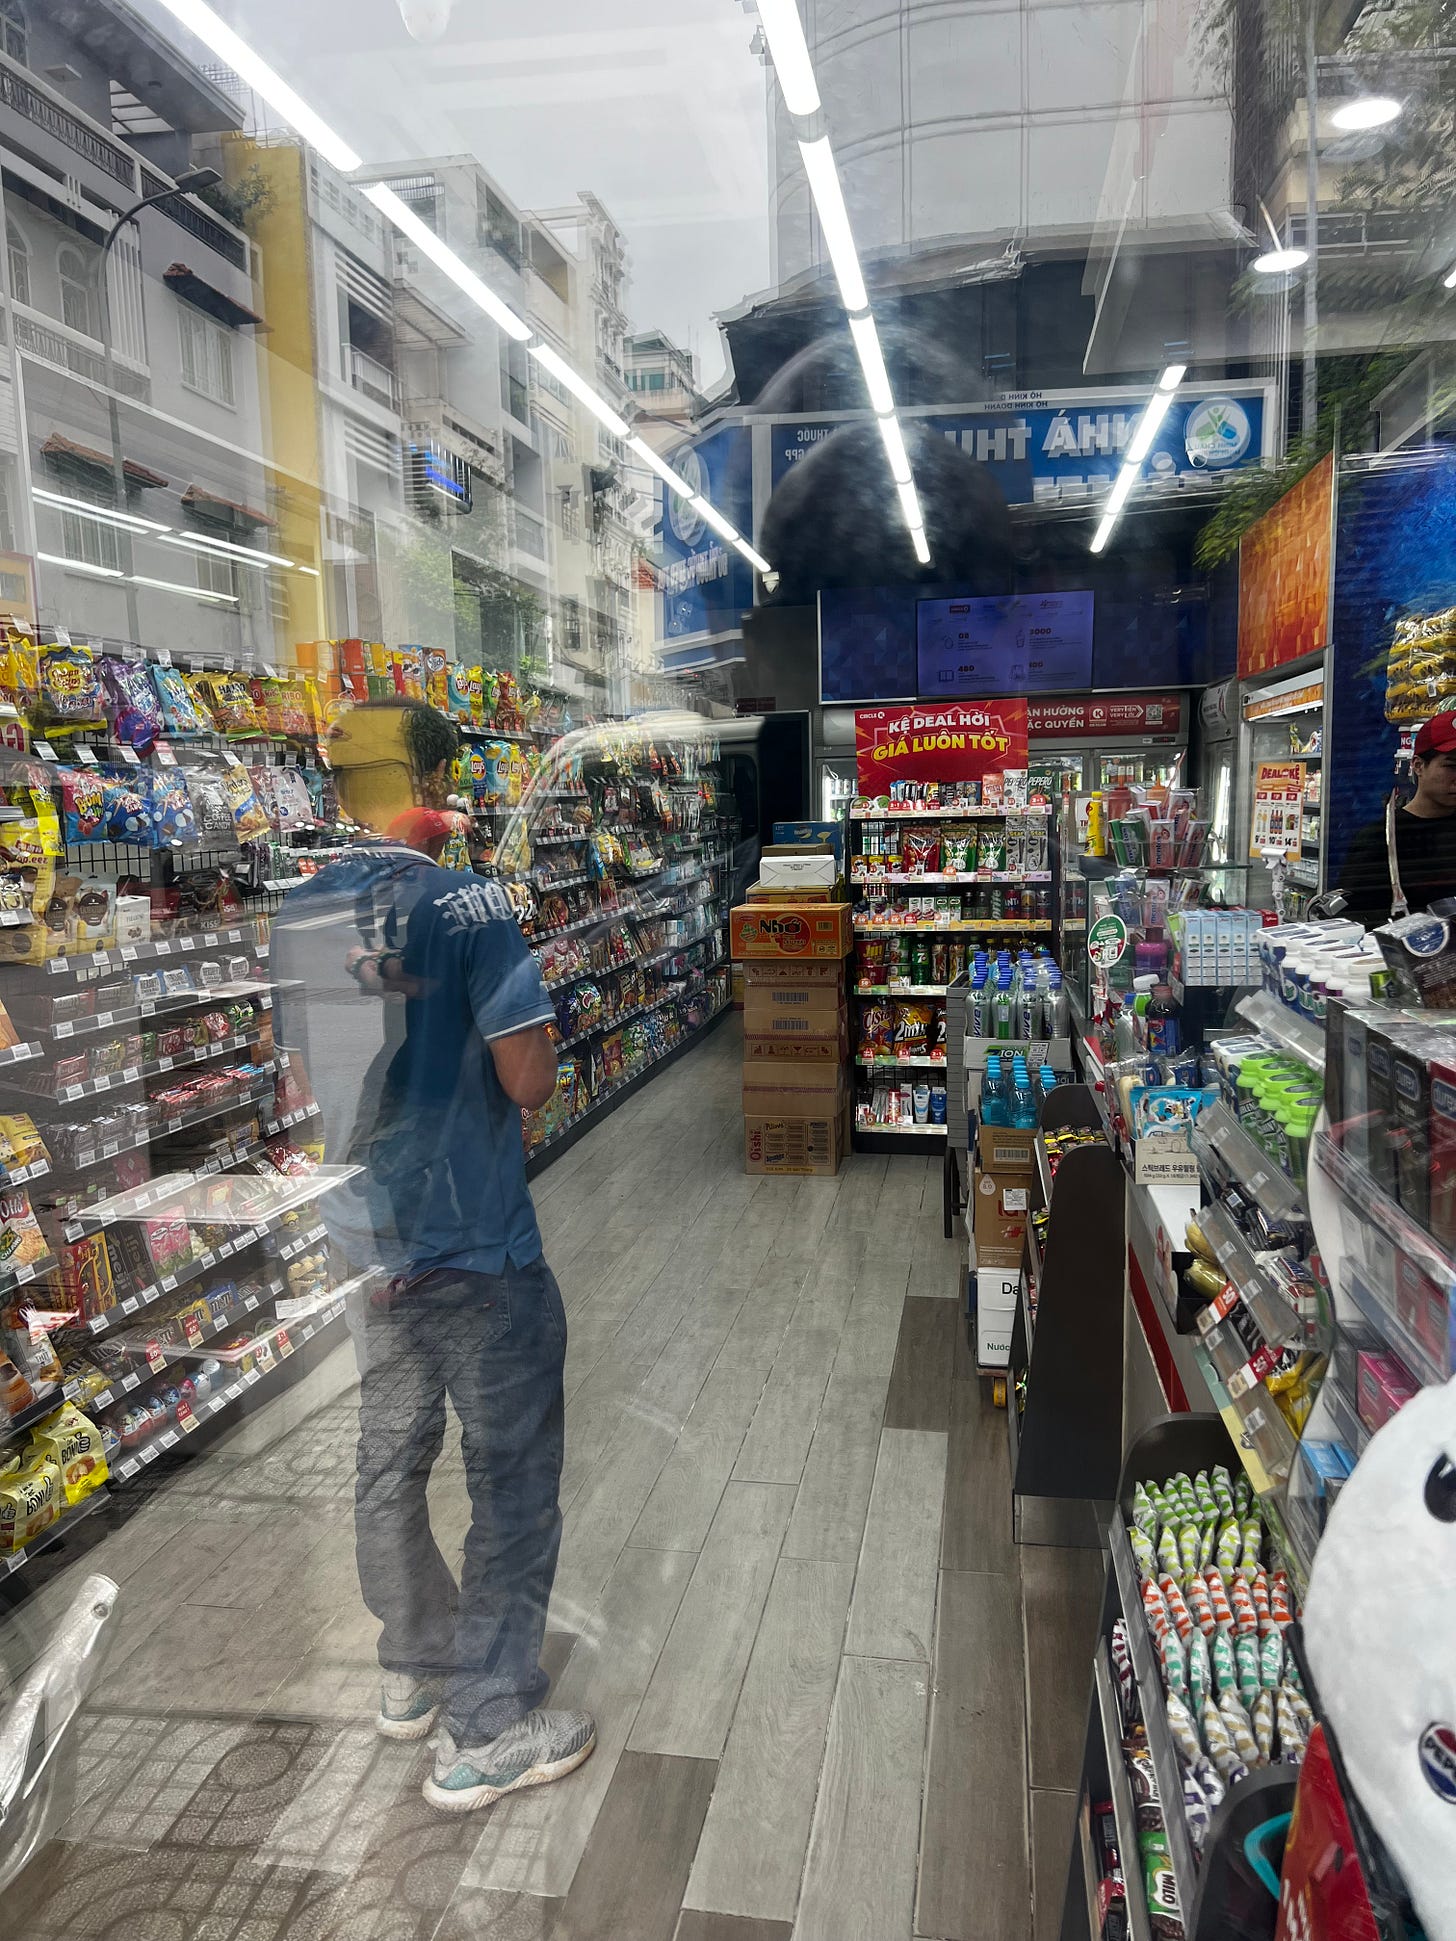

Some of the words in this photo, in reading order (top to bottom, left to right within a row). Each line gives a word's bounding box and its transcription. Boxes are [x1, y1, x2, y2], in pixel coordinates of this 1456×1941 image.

[1043, 704, 1085, 716] HƯỞNG
[888, 716, 911, 734] KỆ
[913, 714, 957, 729] DEAL
[959, 711, 991, 727] HỜI
[1044, 717, 1085, 729] QUYỀN
[873, 738, 910, 762] GIÁ
[912, 729, 966, 754] LUÔN
[968, 730, 1009, 753] TỐT
[1028, 777, 1052, 787] PEPERO
[107, 1245, 131, 1290] meiji
[1162, 1873, 1176, 1905] MILO
